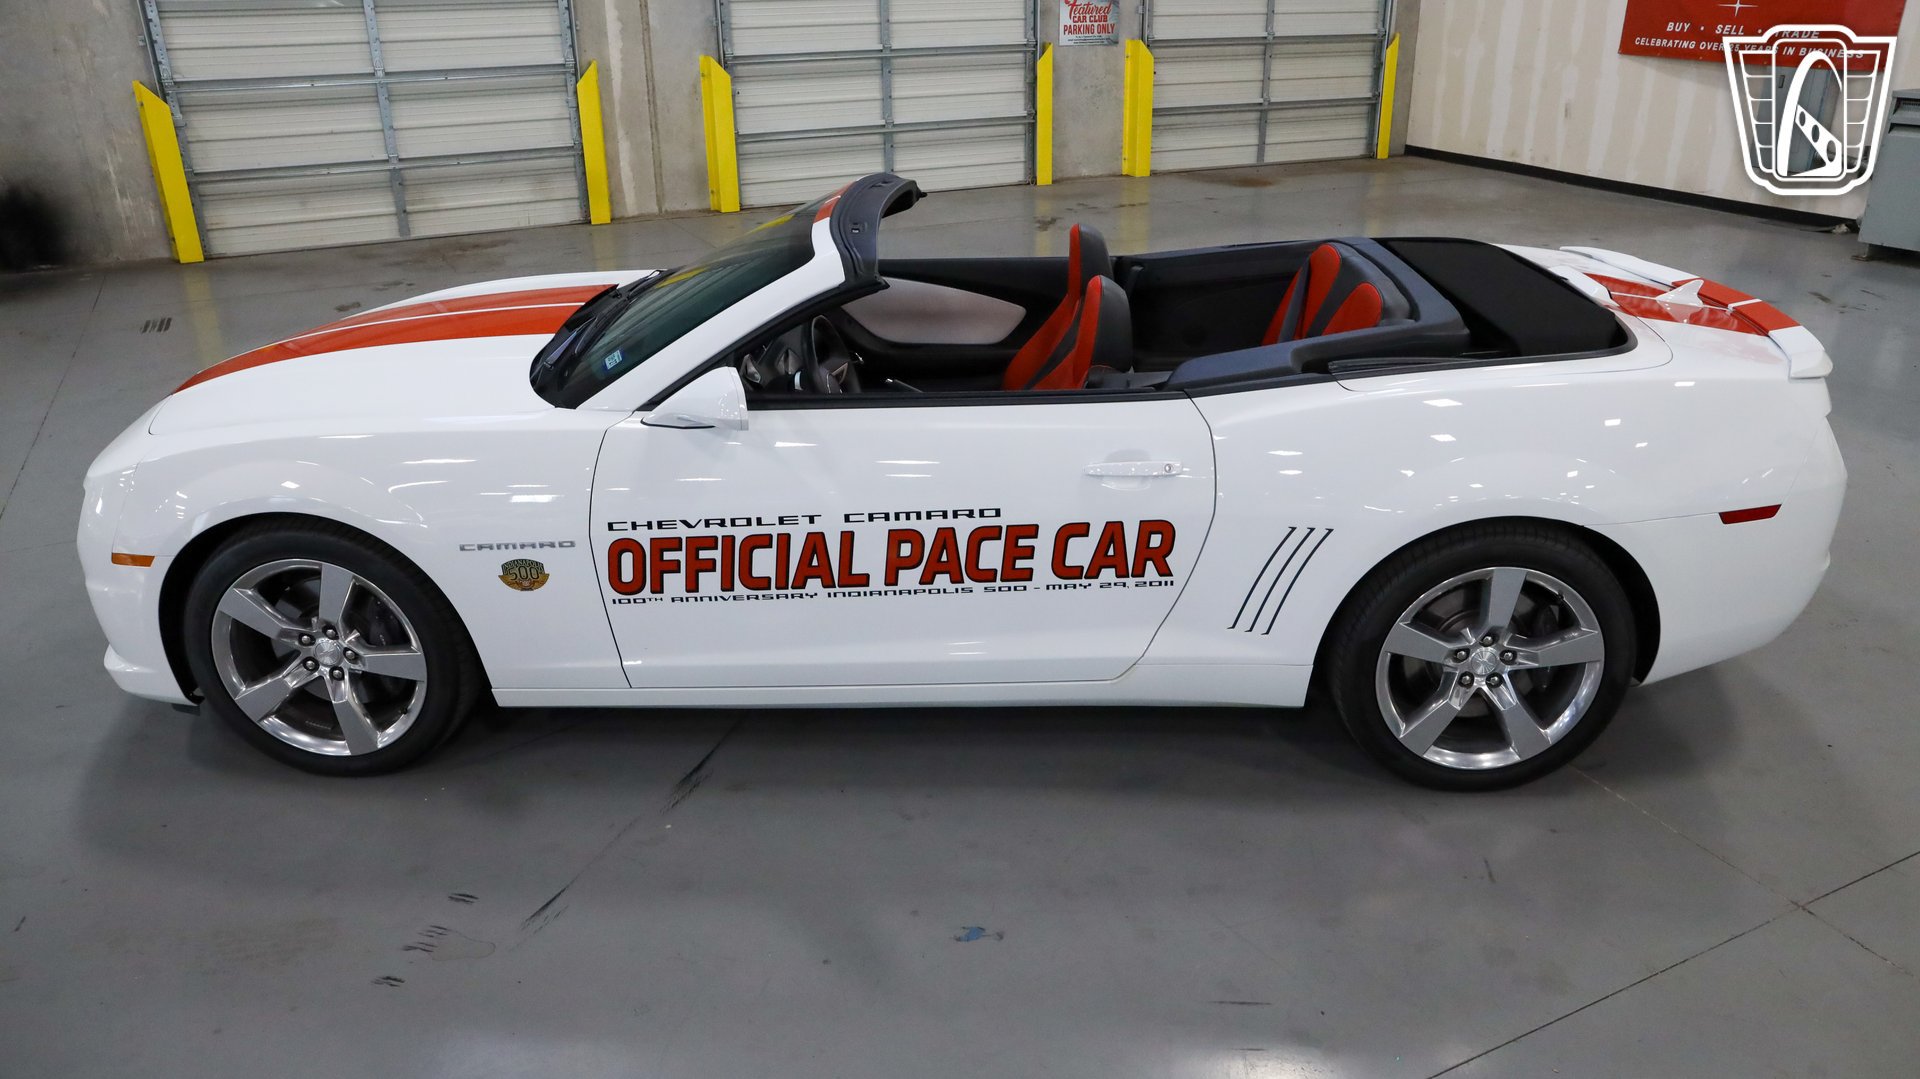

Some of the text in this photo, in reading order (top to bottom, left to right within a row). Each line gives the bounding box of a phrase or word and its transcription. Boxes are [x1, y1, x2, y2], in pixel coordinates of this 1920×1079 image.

[1064, 0, 1112, 20] Featured
[1072, 15, 1108, 23] CAR CLUB
[1063, 23, 1115, 35] PARKING ONLY
[1666, 22, 1691, 33] BUY
[1715, 24, 1746, 35] SELL
[1634, 37, 1696, 49] CELEBRATING
[1699, 40, 1725, 51] OVER
[1782, 46, 1796, 56] IN
[607, 508, 1002, 532] CHEVROLET CAMARO
[459, 540, 576, 552] CAMARO
[607, 519, 1176, 596] OFFICIAL PACE CAR
[508, 565, 540, 580] 500
[671, 592, 818, 603] ANNIVERSARY
[827, 586, 974, 598] INDIANAPOLIS
[983, 585, 1027, 593] 500
[1046, 583, 1092, 591] MAY
[1134, 580, 1175, 588] 2011
